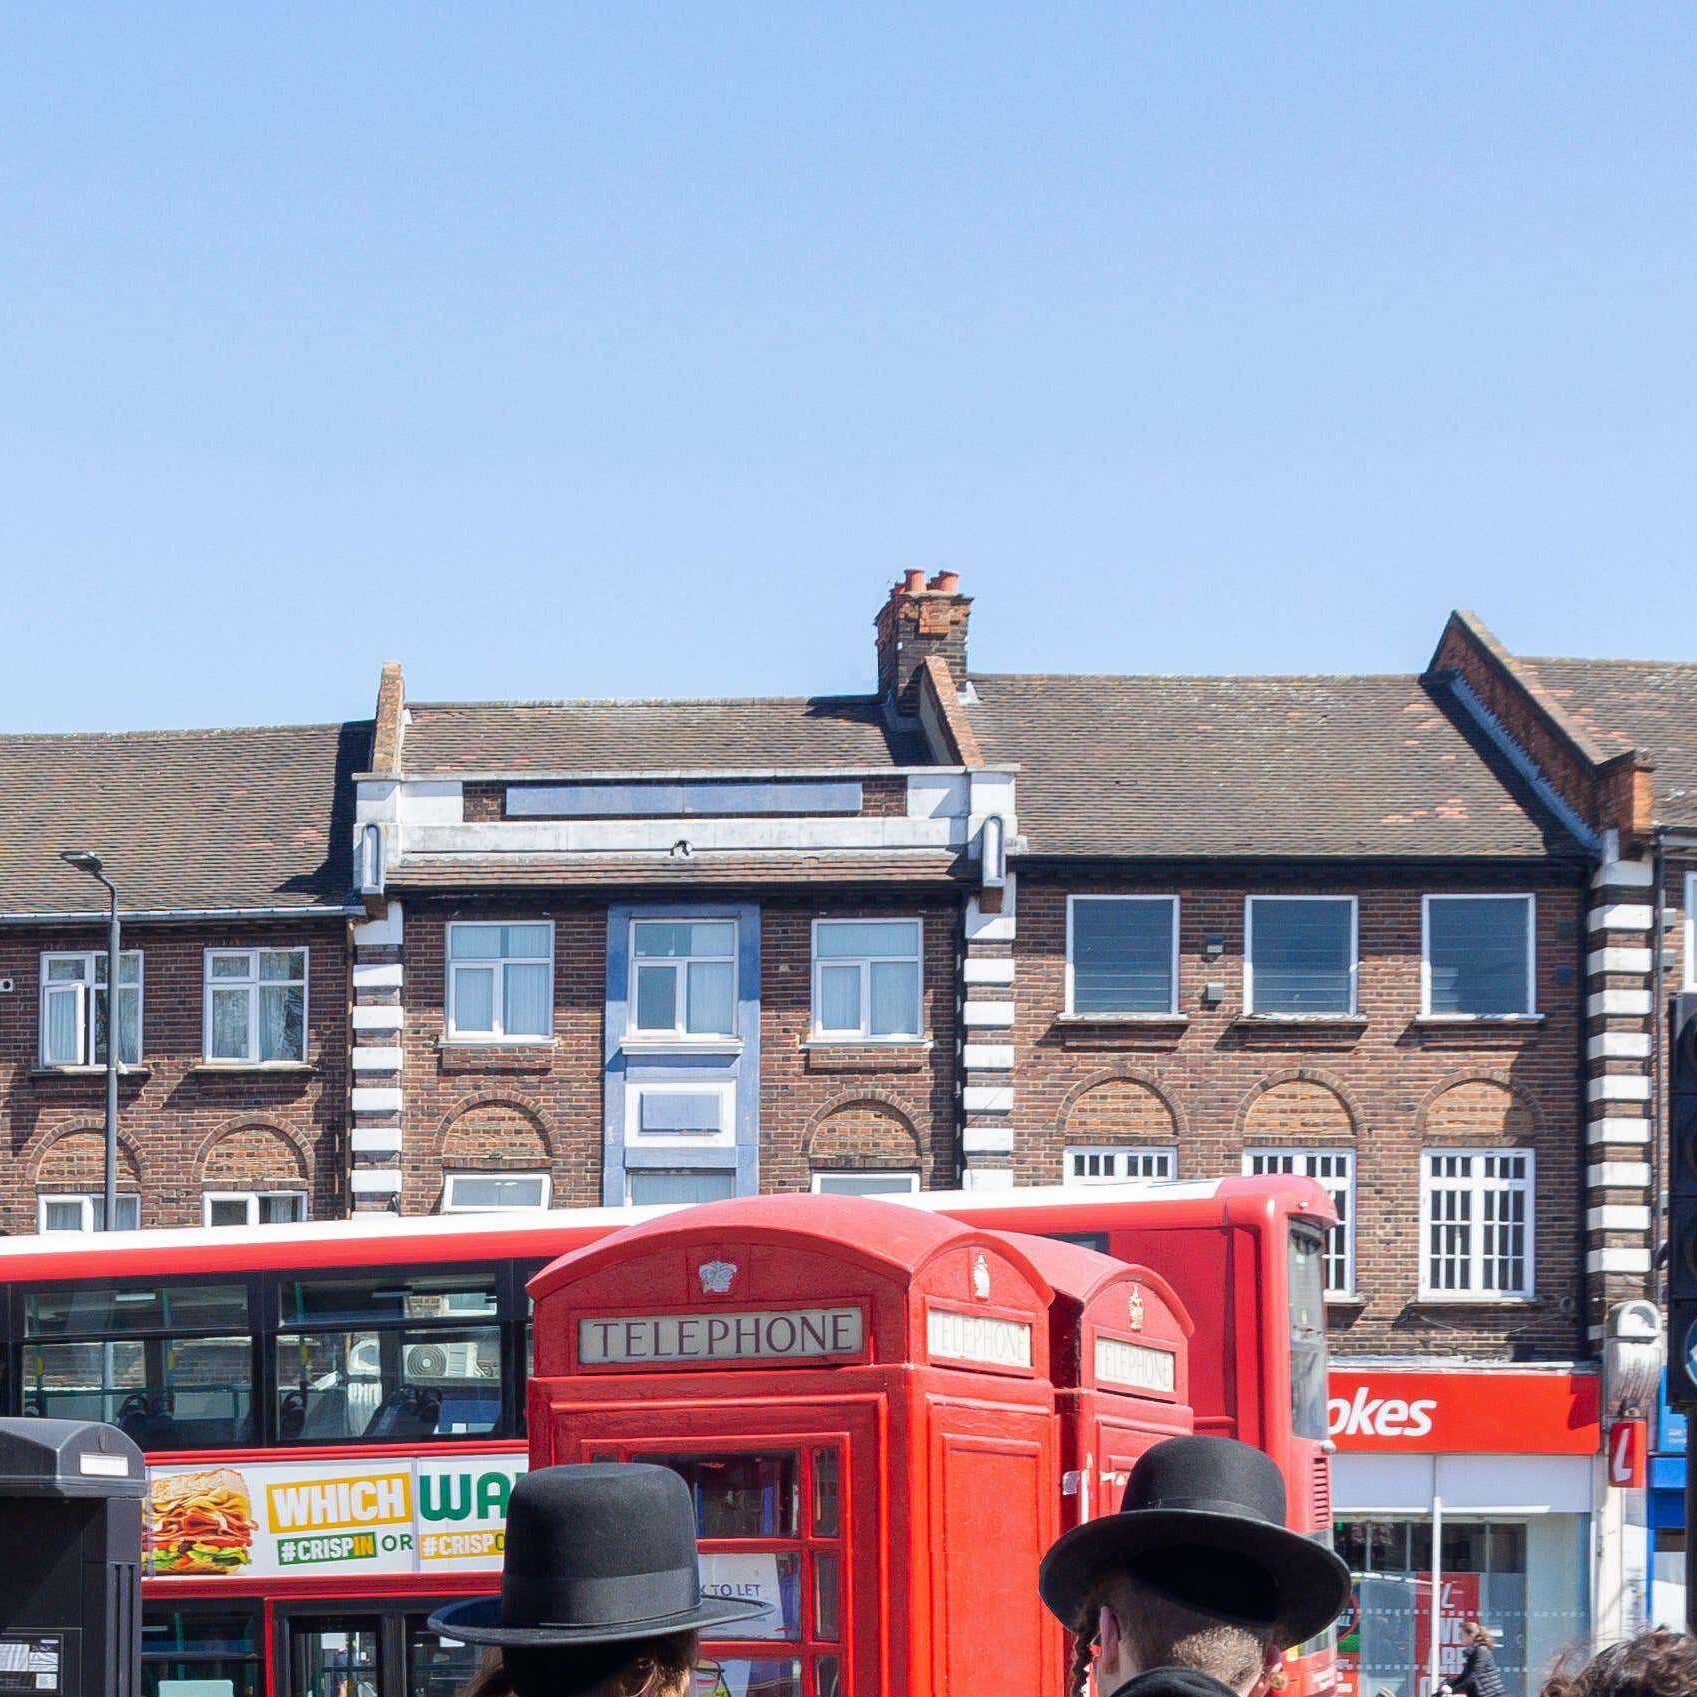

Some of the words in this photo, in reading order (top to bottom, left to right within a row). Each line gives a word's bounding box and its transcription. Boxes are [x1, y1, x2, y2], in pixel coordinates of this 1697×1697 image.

[593, 1313, 855, 1358] TELEPHONE
[271, 1478, 406, 1528] WHICH
[281, 1535, 374, 1562] #CRISPIN
[381, 1534, 413, 1551] OR
[710, 1584, 732, 1596] TO
[737, 1584, 761, 1596] LET
